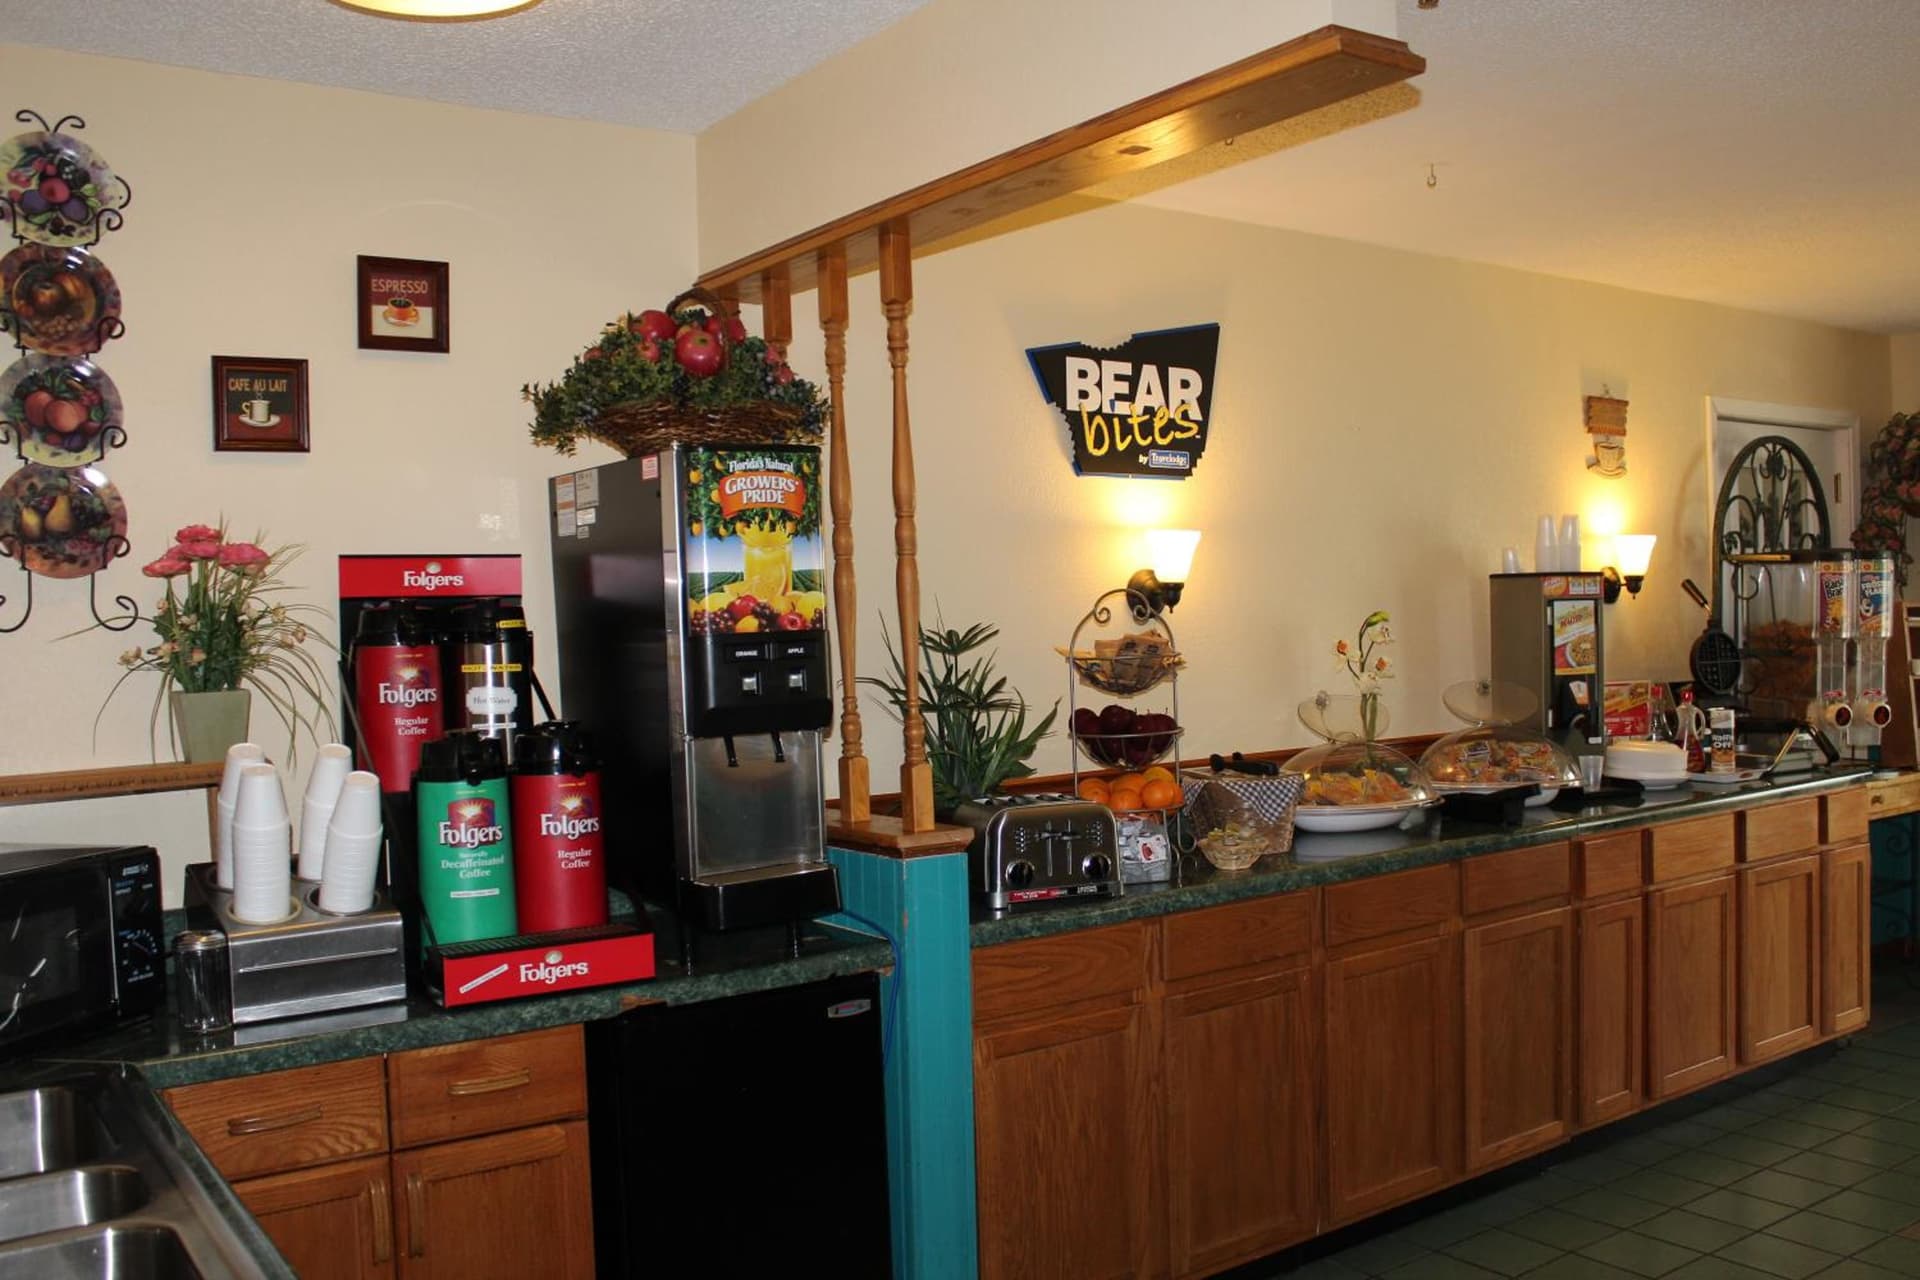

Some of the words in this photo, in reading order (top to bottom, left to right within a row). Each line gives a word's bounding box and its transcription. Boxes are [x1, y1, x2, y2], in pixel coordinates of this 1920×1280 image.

[371, 278, 429, 294] ESPRESSO
[228, 378, 250, 392] CAFE
[253, 379, 266, 392] AU
[268, 379, 288, 393] LAIT
[1065, 356, 1203, 421] BEAR
[1078, 402, 1199, 456] bites
[729, 457, 764, 473] Florida's
[764, 457, 794, 473] Natural
[1138, 453, 1149, 465] by
[742, 489, 785, 504] PRIDE
[403, 570, 464, 590] Folgers
[378, 682, 437, 708] Folgers
[394, 716, 428, 727] Regular
[398, 726, 427, 736] Coffee
[540, 813, 599, 840] Folgers
[439, 821, 503, 848] Folgers
[558, 847, 592, 860] Regular
[441, 854, 505, 869] Decaffeinated
[561, 858, 590, 870] Coffee
[459, 868, 492, 879] Coffee
[519, 962, 589, 985] Folgers
